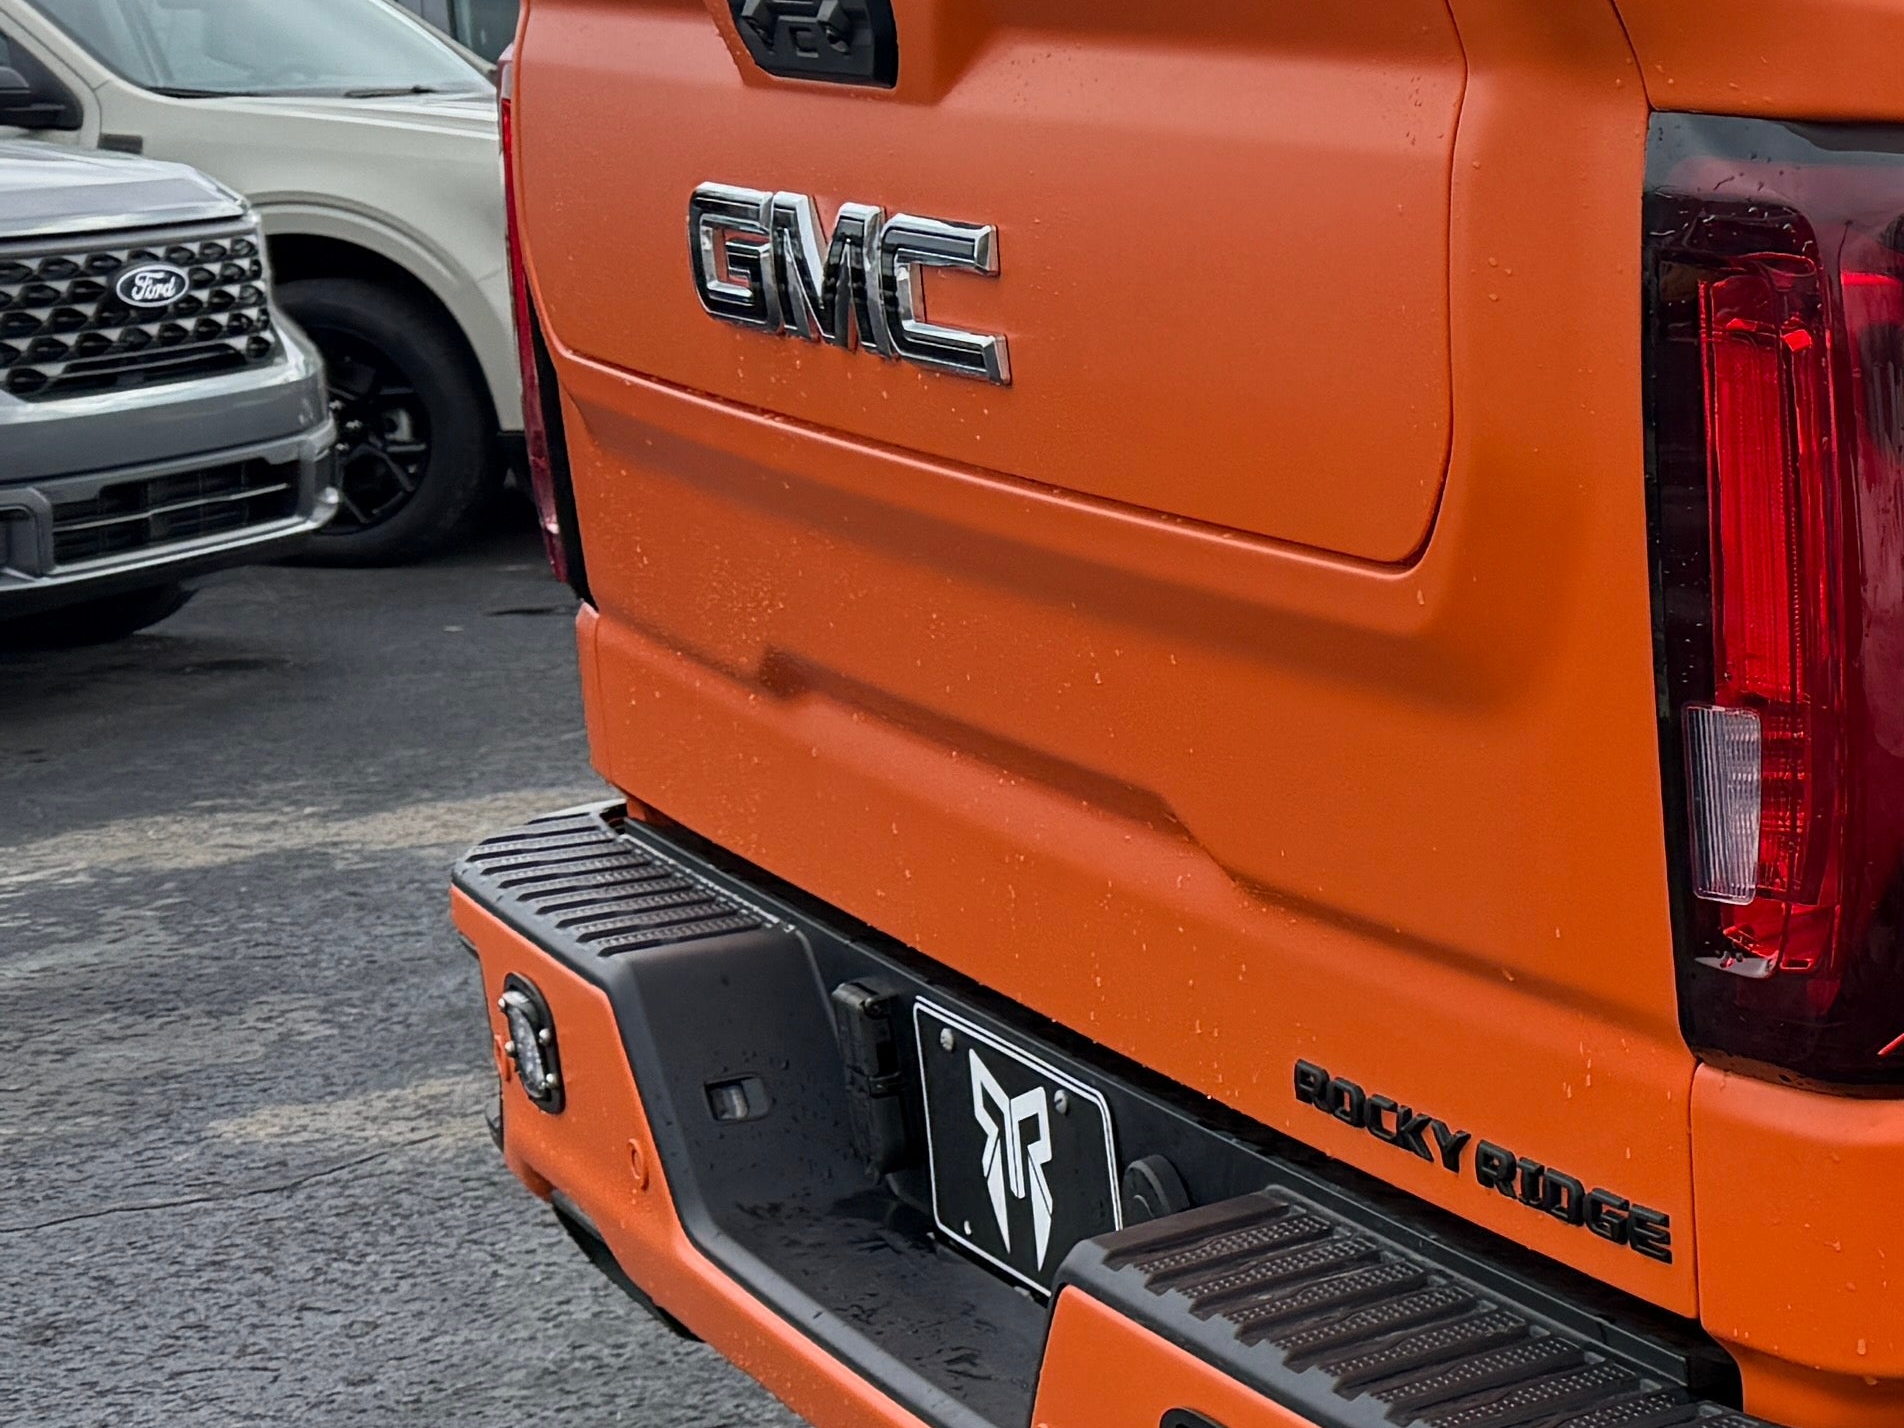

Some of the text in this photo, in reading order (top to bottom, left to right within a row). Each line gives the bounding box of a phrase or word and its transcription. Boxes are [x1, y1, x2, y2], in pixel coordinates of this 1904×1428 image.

[131, 272, 177, 301] Ford
[688, 180, 1013, 388] GMC
[1294, 1058, 1673, 1265] ROCKY RIDGE
